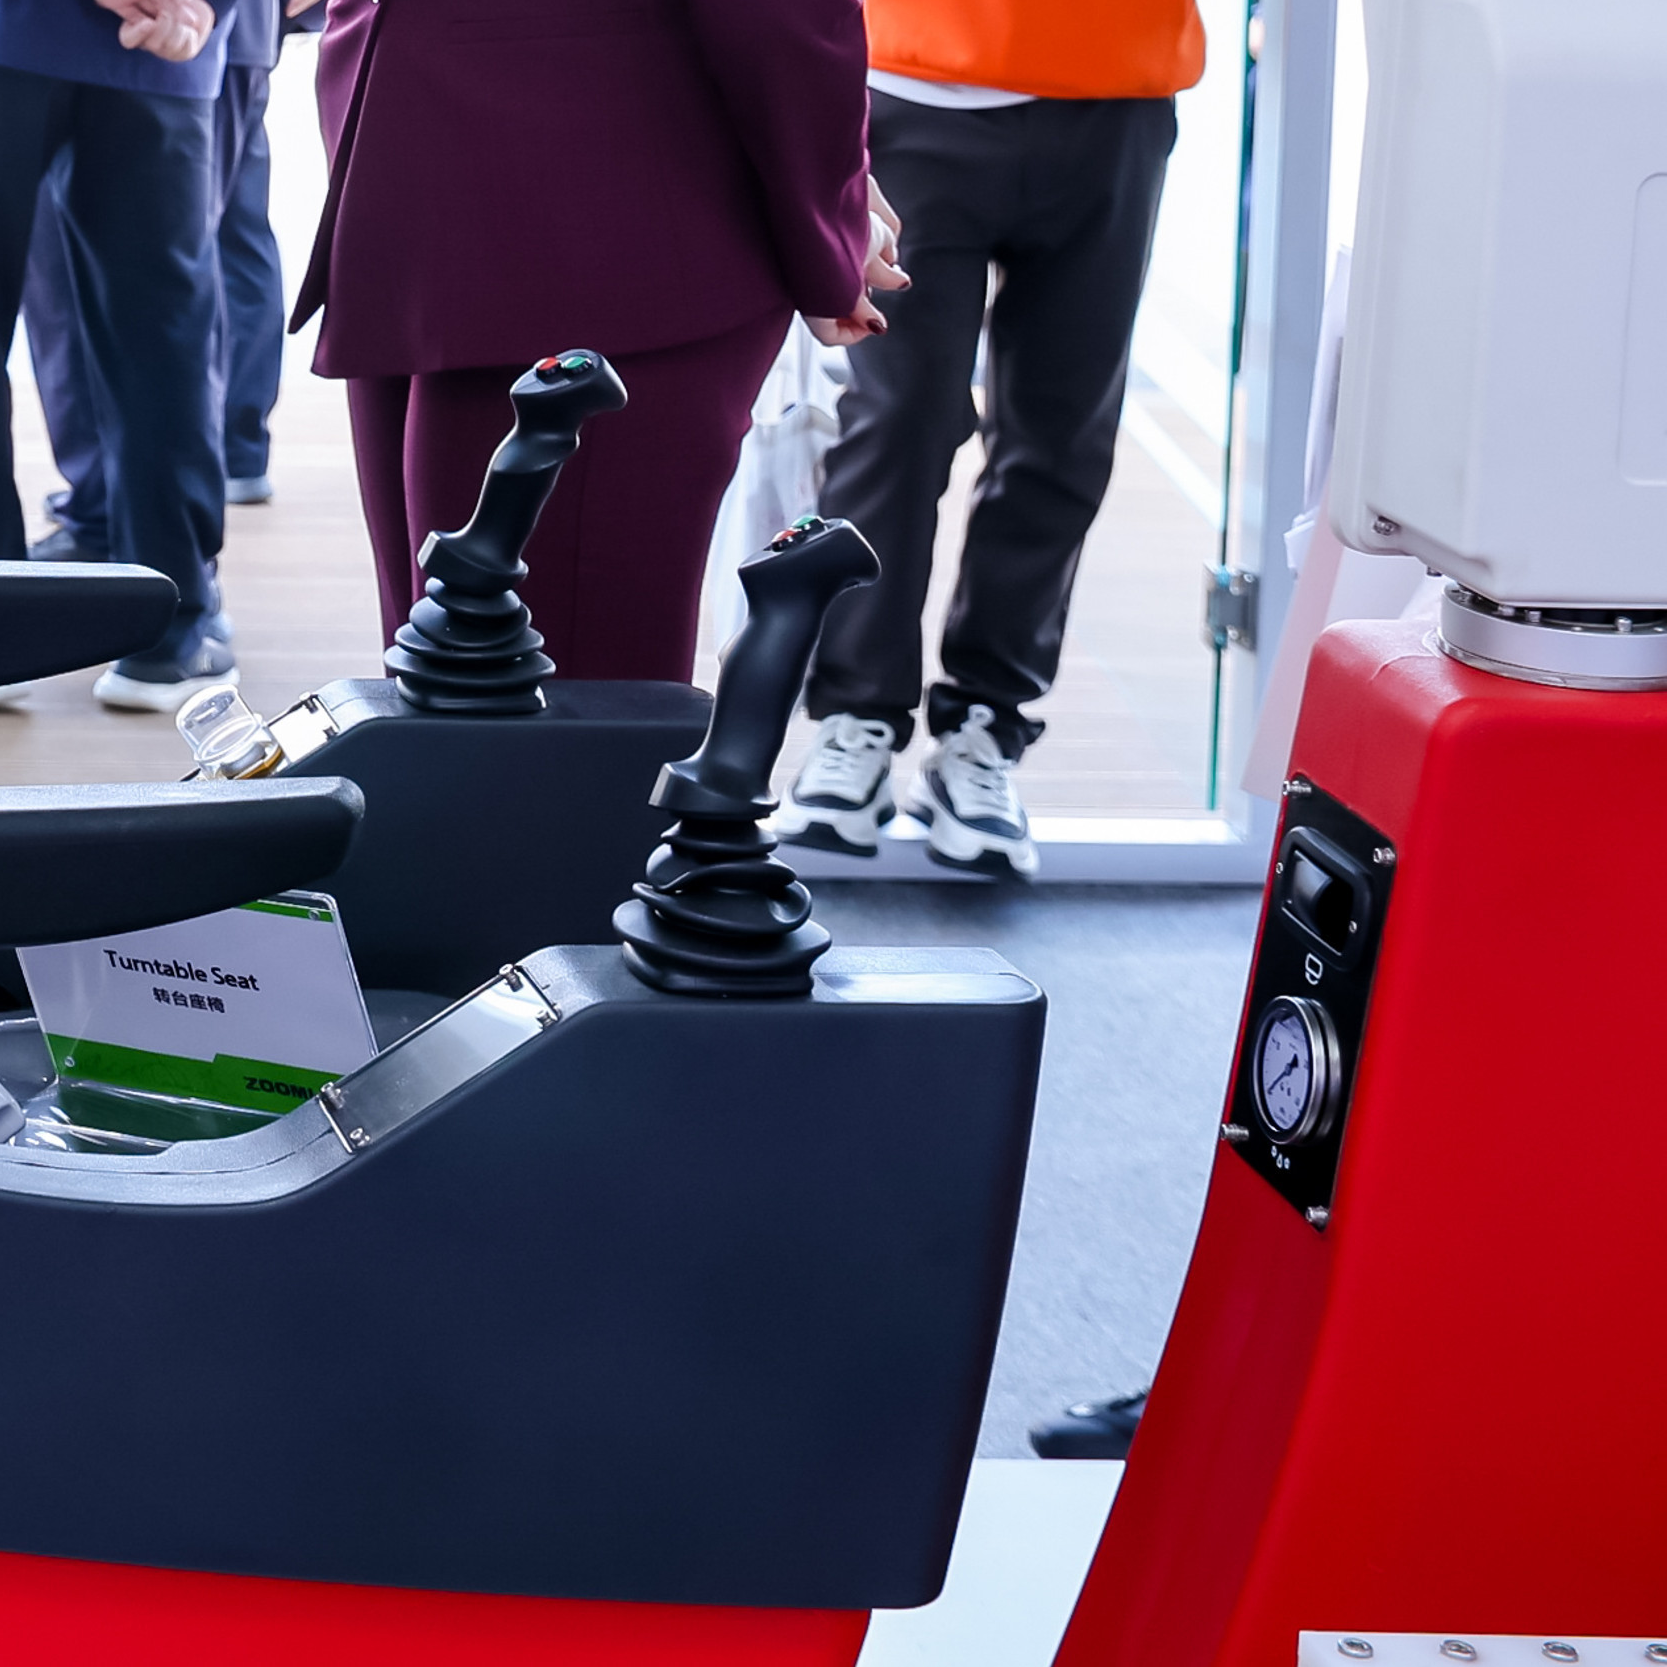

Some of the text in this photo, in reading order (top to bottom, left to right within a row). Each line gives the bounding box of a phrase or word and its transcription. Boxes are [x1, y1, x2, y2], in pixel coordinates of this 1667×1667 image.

[103, 949, 260, 991] Turntable Seat
[152, 986, 226, 1014] 转台座椅
